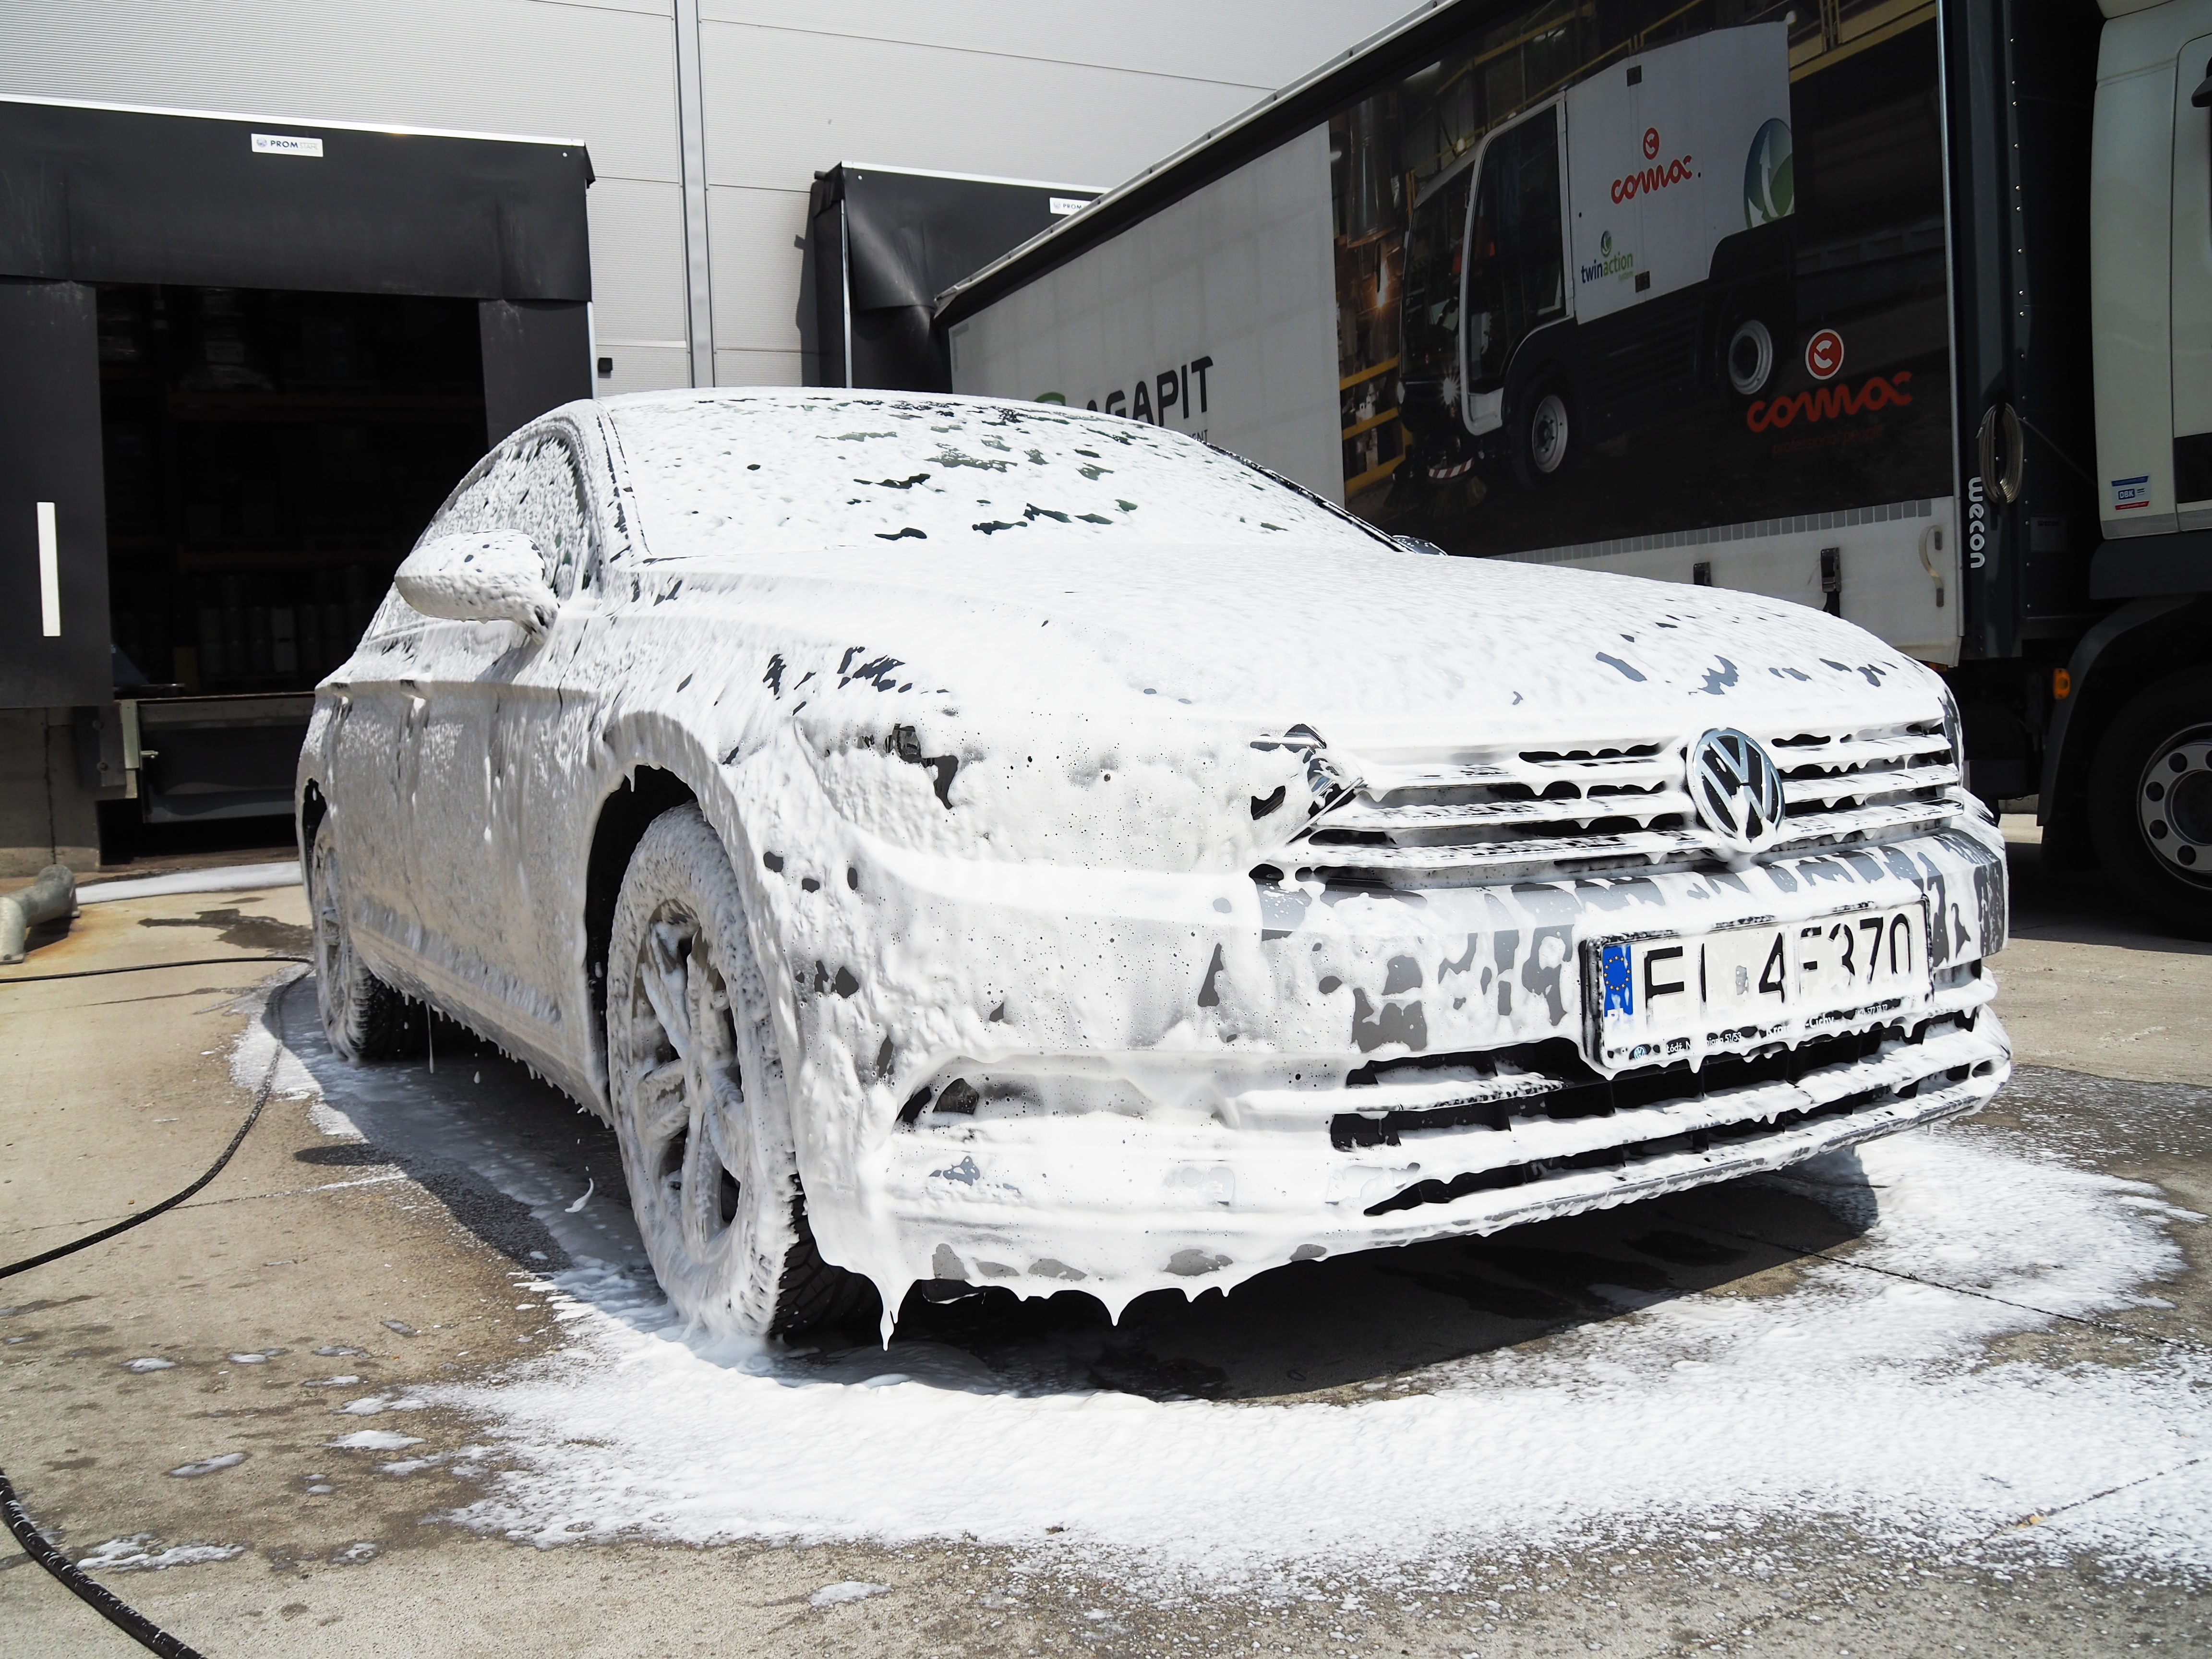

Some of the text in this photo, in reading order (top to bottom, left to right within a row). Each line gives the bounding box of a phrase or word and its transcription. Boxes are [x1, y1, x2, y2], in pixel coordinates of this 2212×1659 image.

[1611, 155, 1692, 204] comac
[1086, 356, 1214, 427] GAPIT
[1747, 371, 1913, 432] comac
[1968, 477, 1985, 568] wecon
